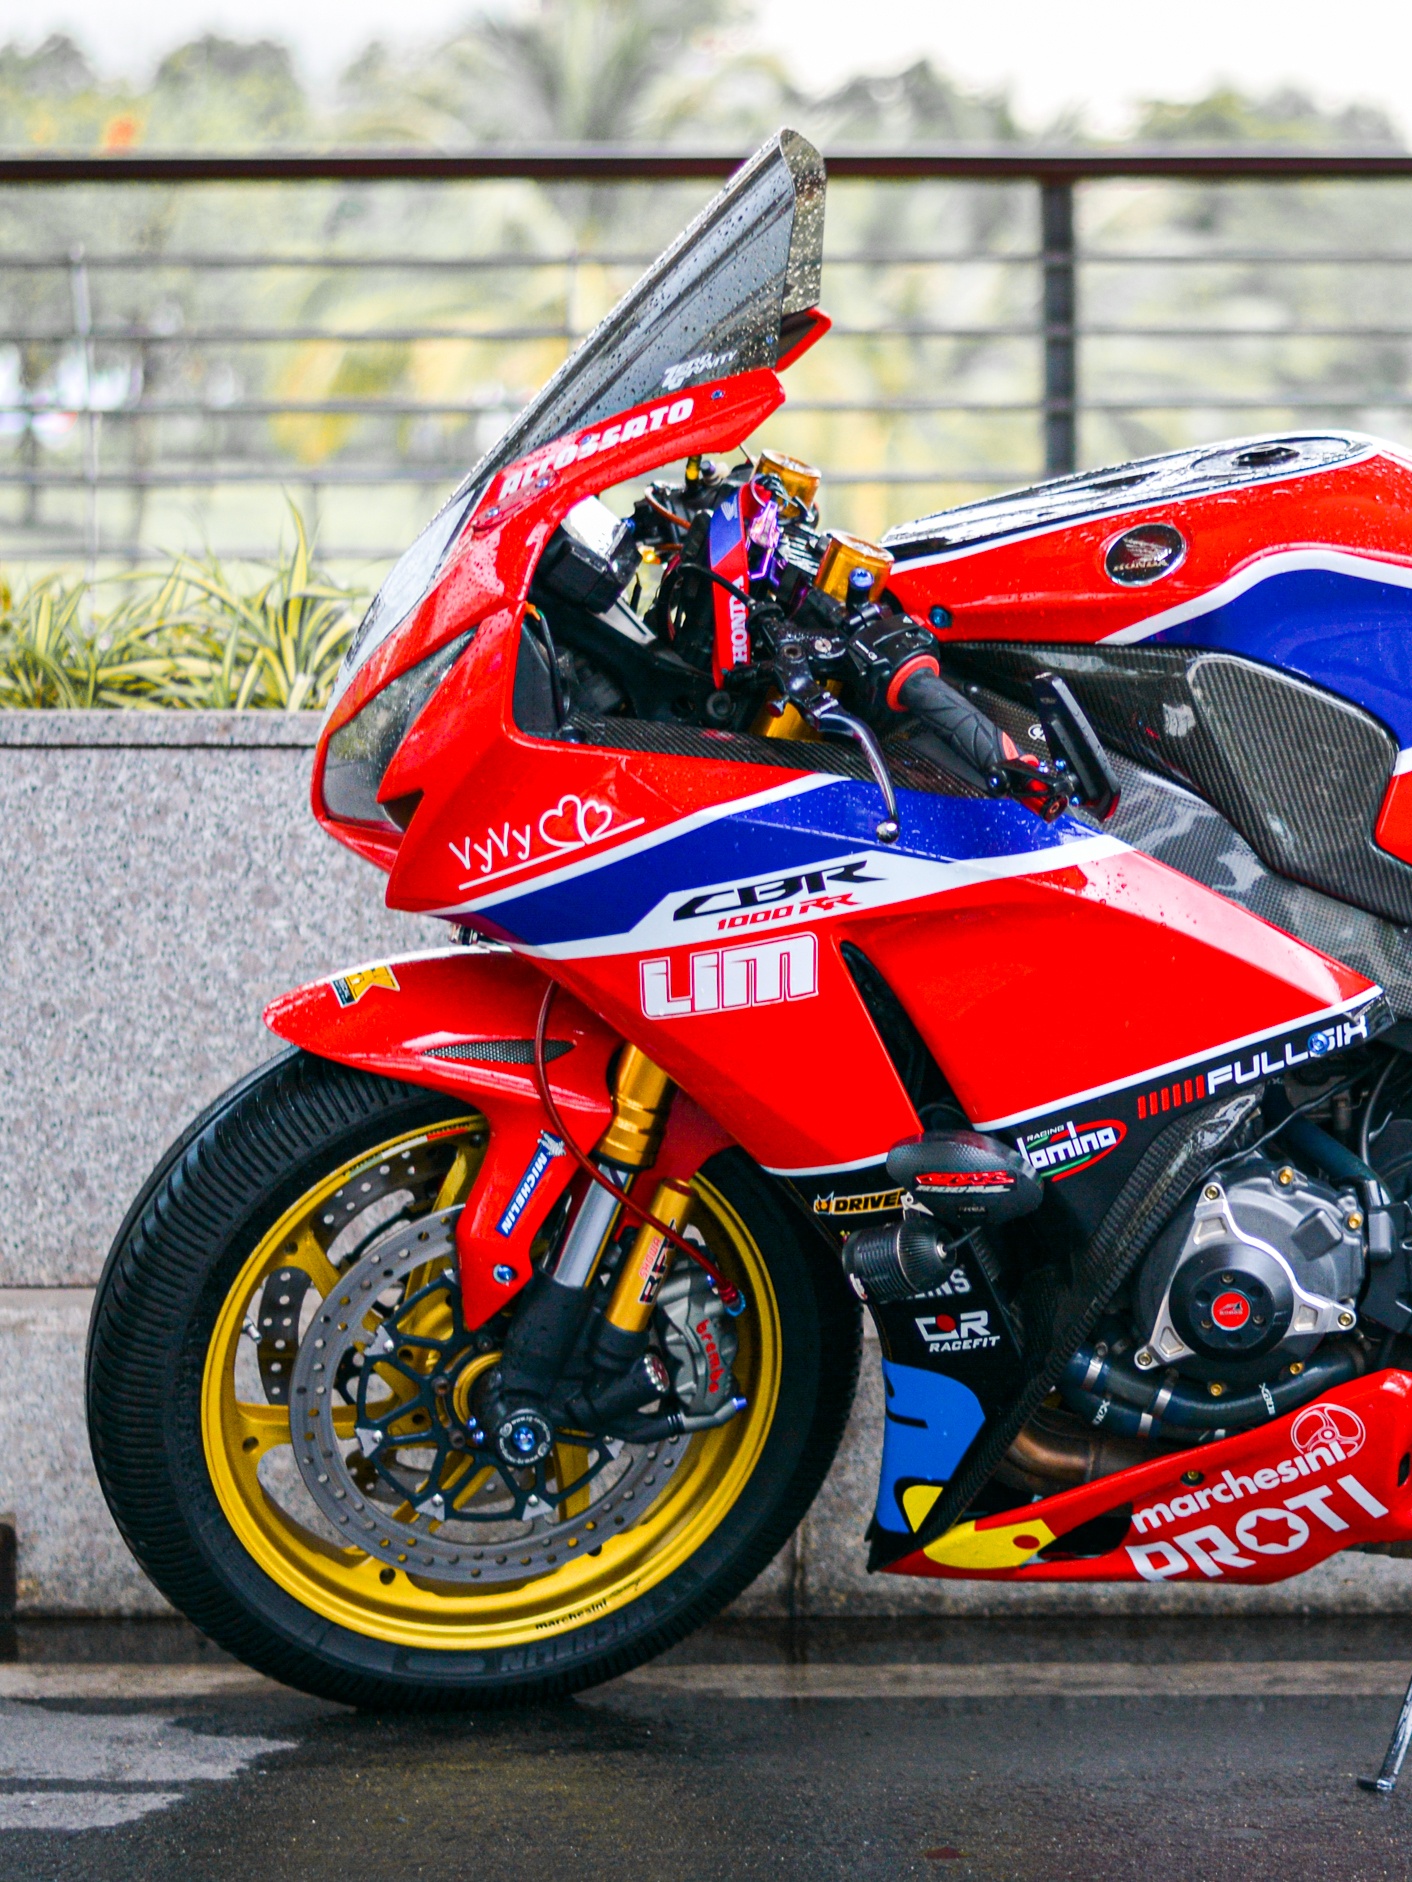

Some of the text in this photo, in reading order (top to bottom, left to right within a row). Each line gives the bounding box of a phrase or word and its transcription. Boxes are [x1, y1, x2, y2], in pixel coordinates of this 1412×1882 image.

[498, 398, 694, 500] ACCOSSATO
[449, 821, 531, 874] VyVy
[673, 860, 888, 922] CBR
[1027, 1124, 1065, 1142] RACING
[501, 1152, 548, 1235] MICHELIN
[696, 1318, 725, 1394] brembo
[929, 1336, 1000, 1353] RACEFIT
[1131, 1441, 1346, 1534] marchesini
[1125, 1474, 1389, 1582] PROTI
